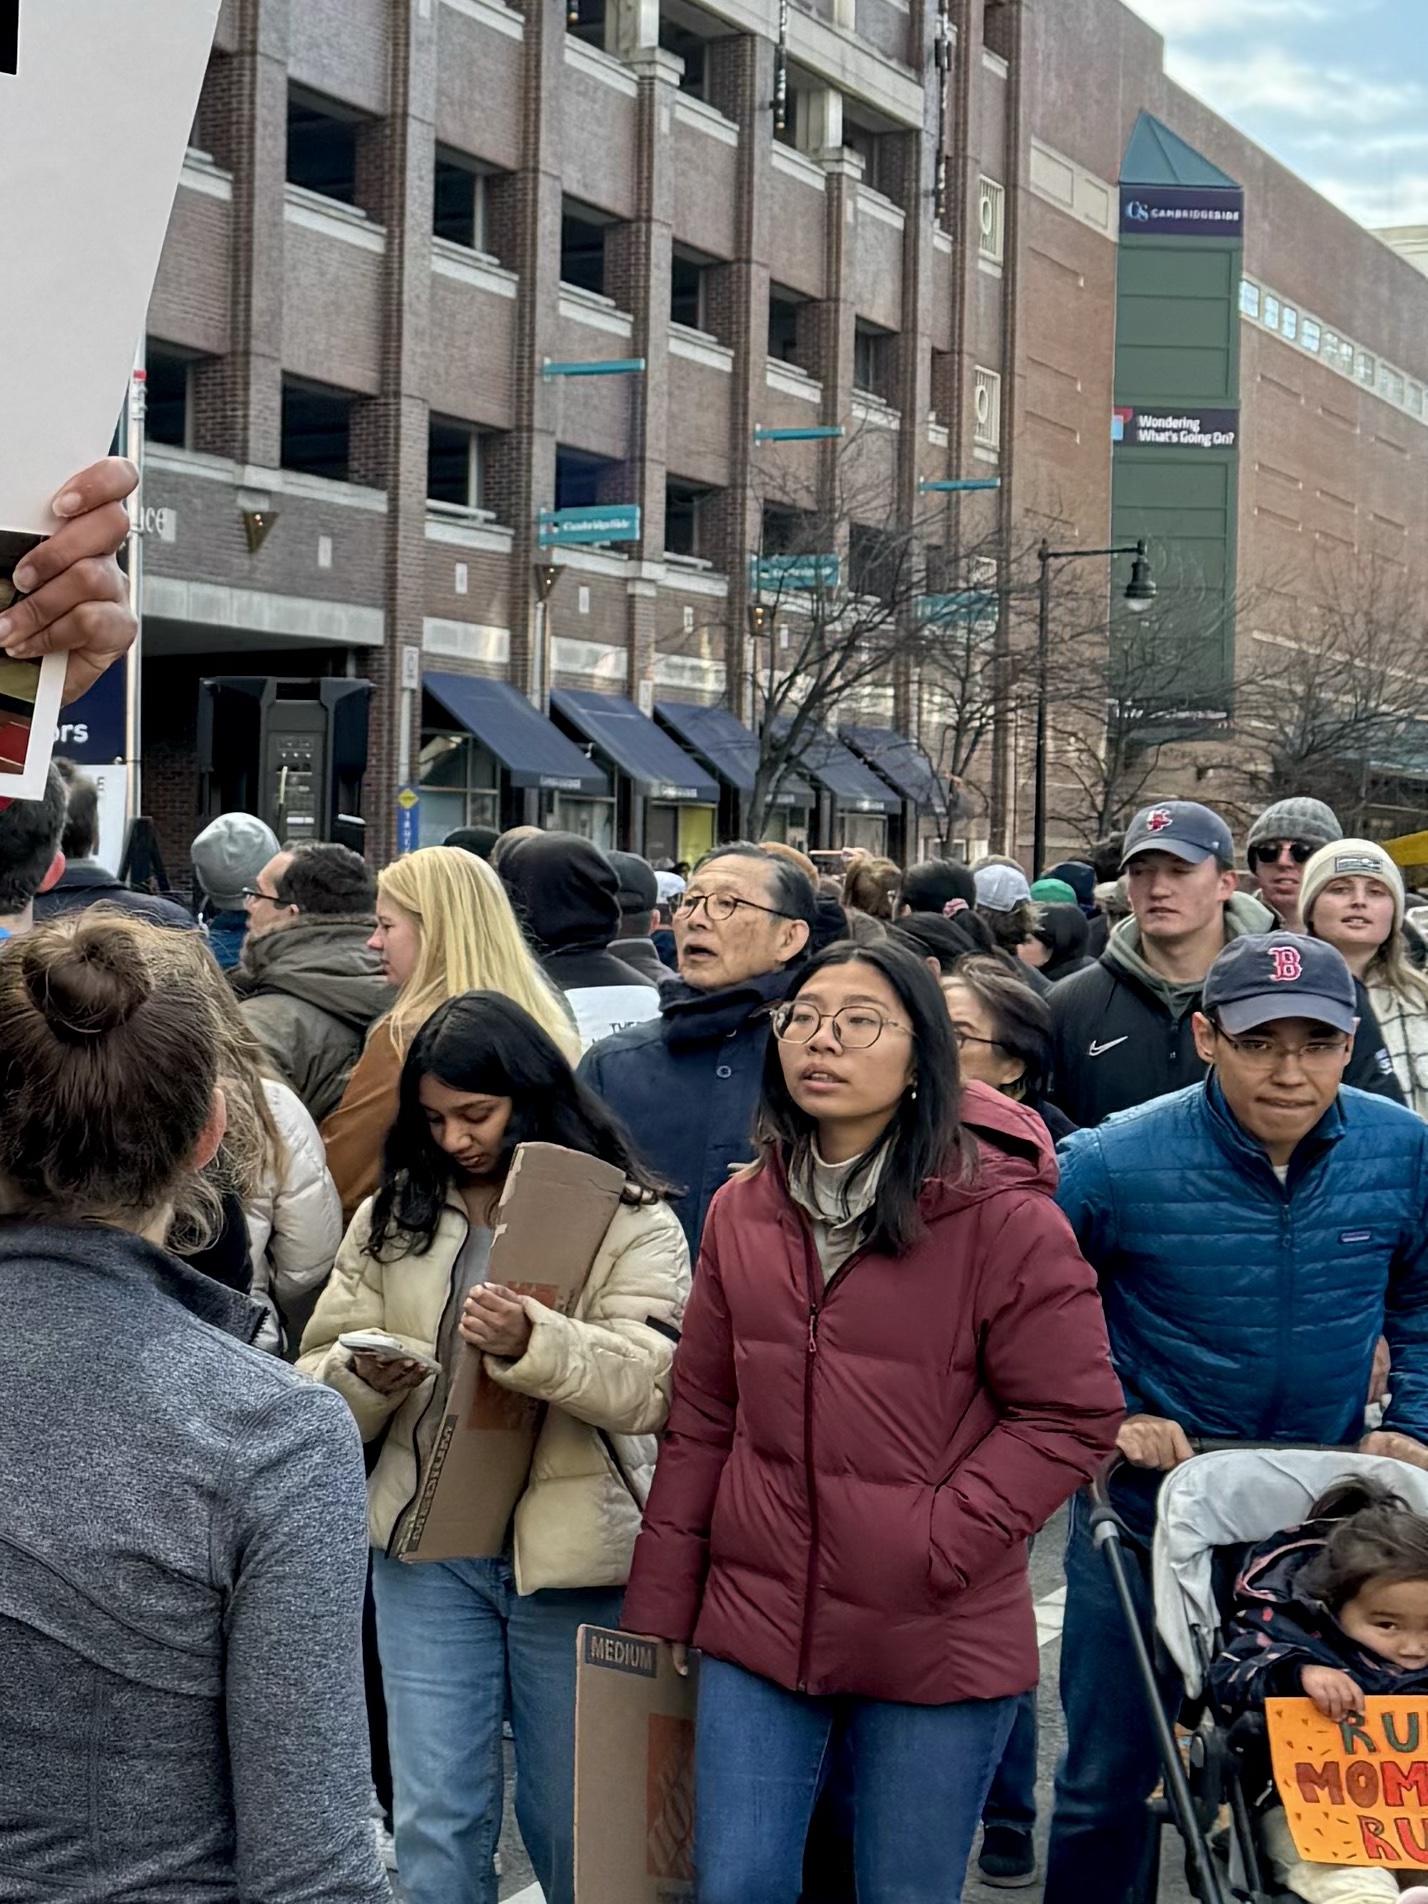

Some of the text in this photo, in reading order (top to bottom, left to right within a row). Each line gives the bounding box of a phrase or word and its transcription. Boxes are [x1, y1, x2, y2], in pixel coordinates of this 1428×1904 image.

[1139, 414, 1200, 432] Wondering
[1139, 429, 1235, 447] What's Going On?
[1267, 945, 1303, 982] B
[591, 1636, 653, 1671] MEDIUM
[1340, 1709, 1428, 1755] RU
